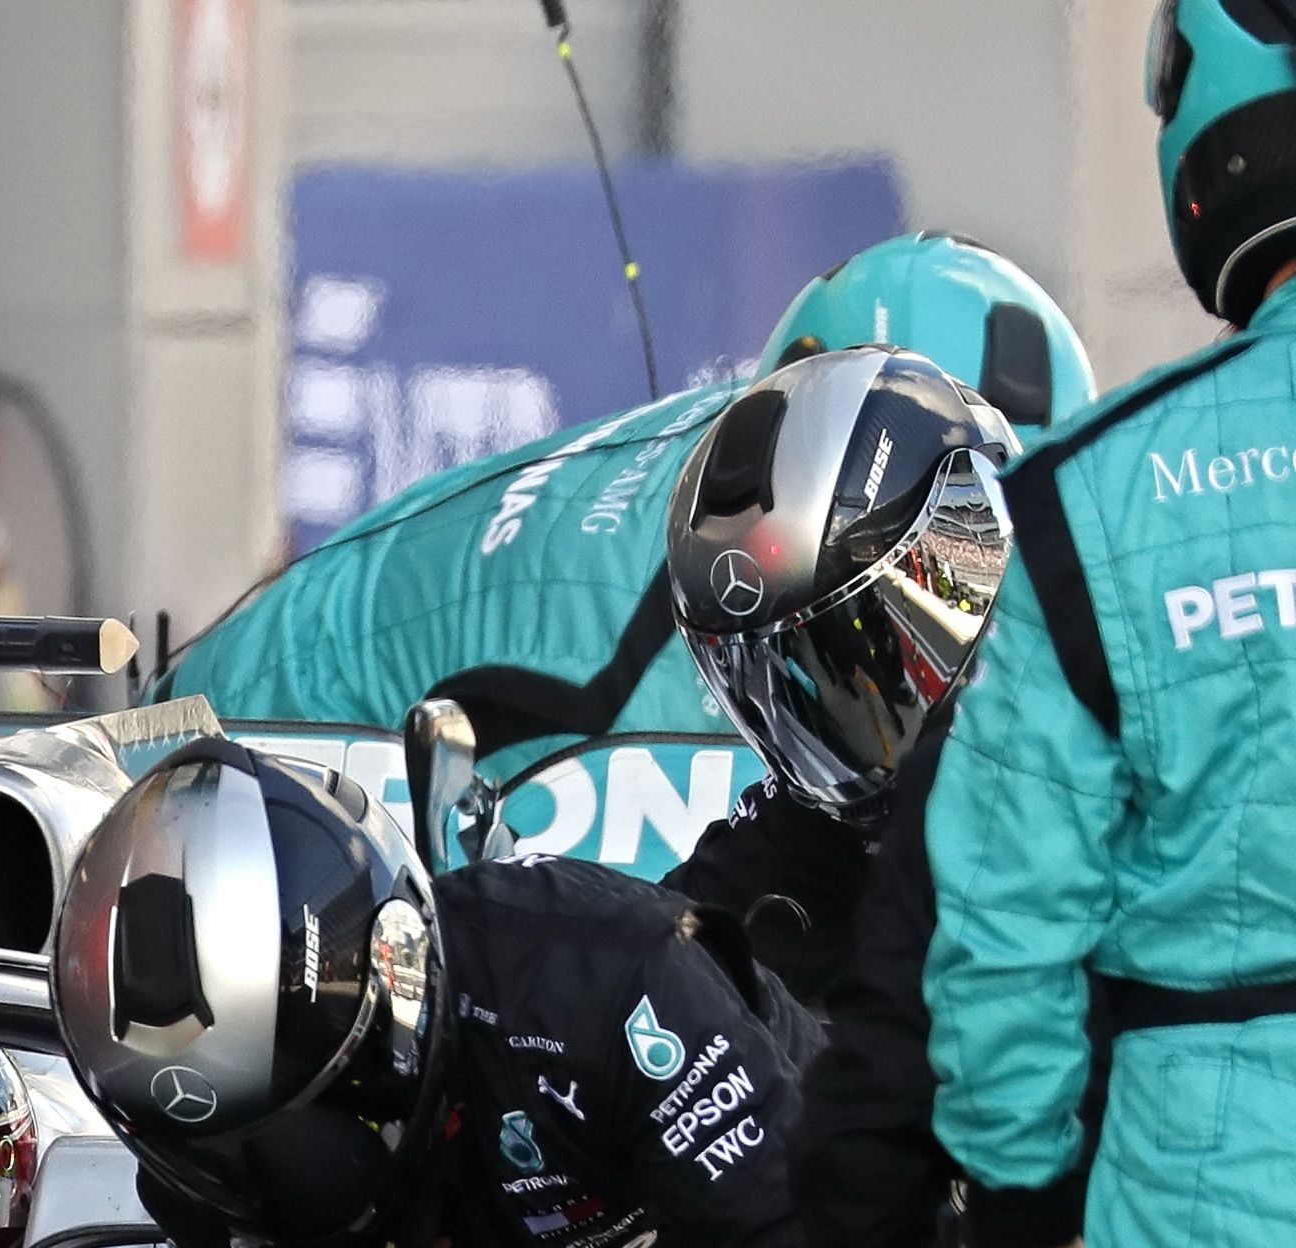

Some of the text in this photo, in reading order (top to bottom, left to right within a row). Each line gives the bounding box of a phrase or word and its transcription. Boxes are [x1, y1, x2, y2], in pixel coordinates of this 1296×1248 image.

[864, 428, 893, 514] BOSE
[1147, 445, 1296, 504] Merc
[303, 903, 320, 1004] BOSE
[649, 1034, 731, 1124] PETRONAS
[661, 1065, 755, 1157] EPSON
[694, 1115, 765, 1181] IWC
